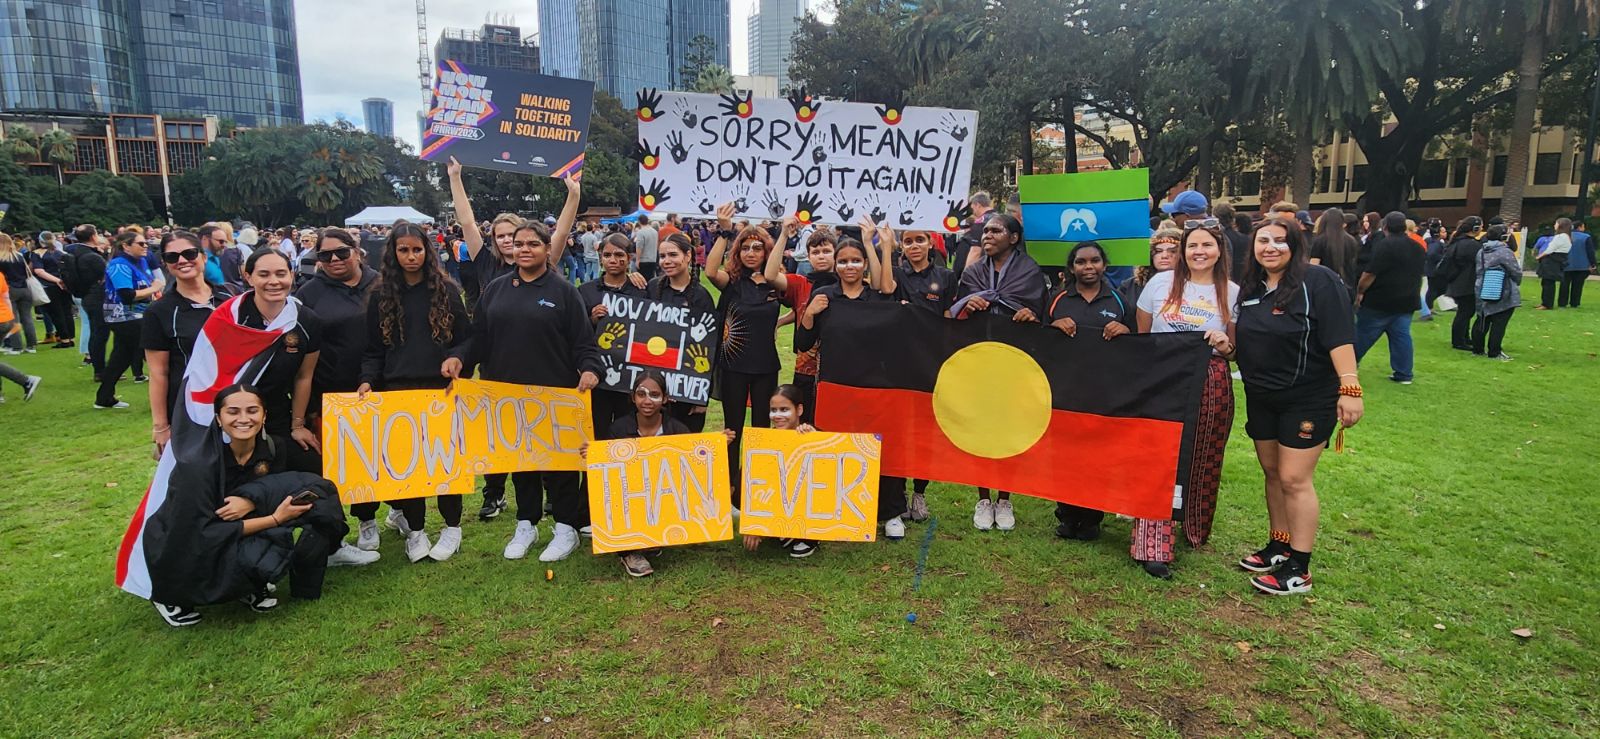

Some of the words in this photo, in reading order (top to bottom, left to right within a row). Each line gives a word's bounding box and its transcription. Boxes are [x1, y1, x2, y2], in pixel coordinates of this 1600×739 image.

[441, 70, 488, 89] NOW
[439, 83, 493, 102] MORE
[520, 93, 571, 112] WALKING
[436, 95, 486, 114] THAN
[433, 109, 480, 126] EVER
[515, 107, 572, 127] TOGETHER
[432, 124, 479, 139] #NRW2024
[500, 120, 511, 134] IN
[515, 123, 582, 143] SOLIDARITY
[699, 115, 816, 161] SORRY
[830, 123, 942, 162] MEANS
[697, 155, 780, 185] DON'T
[786, 163, 822, 188] DO
[828, 163, 855, 189] IT
[602, 292, 644, 320] NOW
[645, 302, 690, 328] MORE
[338, 411, 459, 485] NOW
[455, 394, 581, 455] MORE
[588, 451, 716, 531] THAN
[746, 449, 868, 522] EVER
